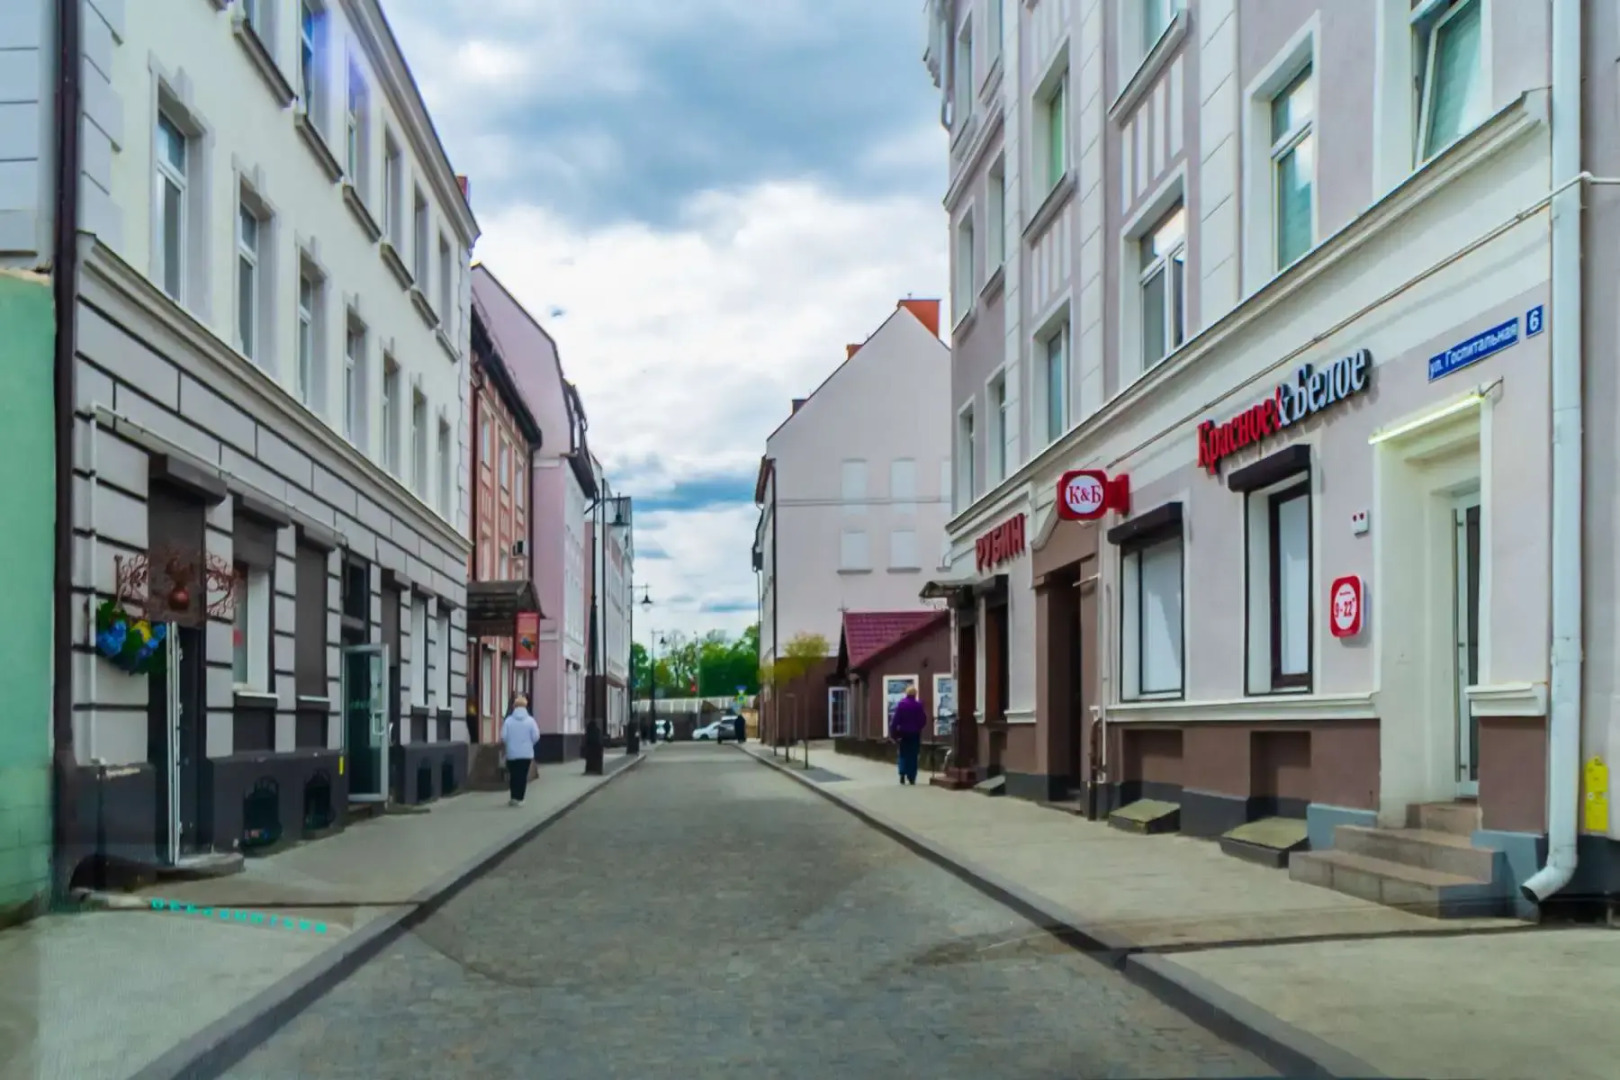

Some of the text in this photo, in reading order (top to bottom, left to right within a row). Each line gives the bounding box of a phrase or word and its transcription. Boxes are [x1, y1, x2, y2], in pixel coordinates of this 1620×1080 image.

[1529, 310, 1540, 332] 6
[1445, 323, 1518, 367] Госпитальная
[975, 512, 1026, 572] РУБИН
